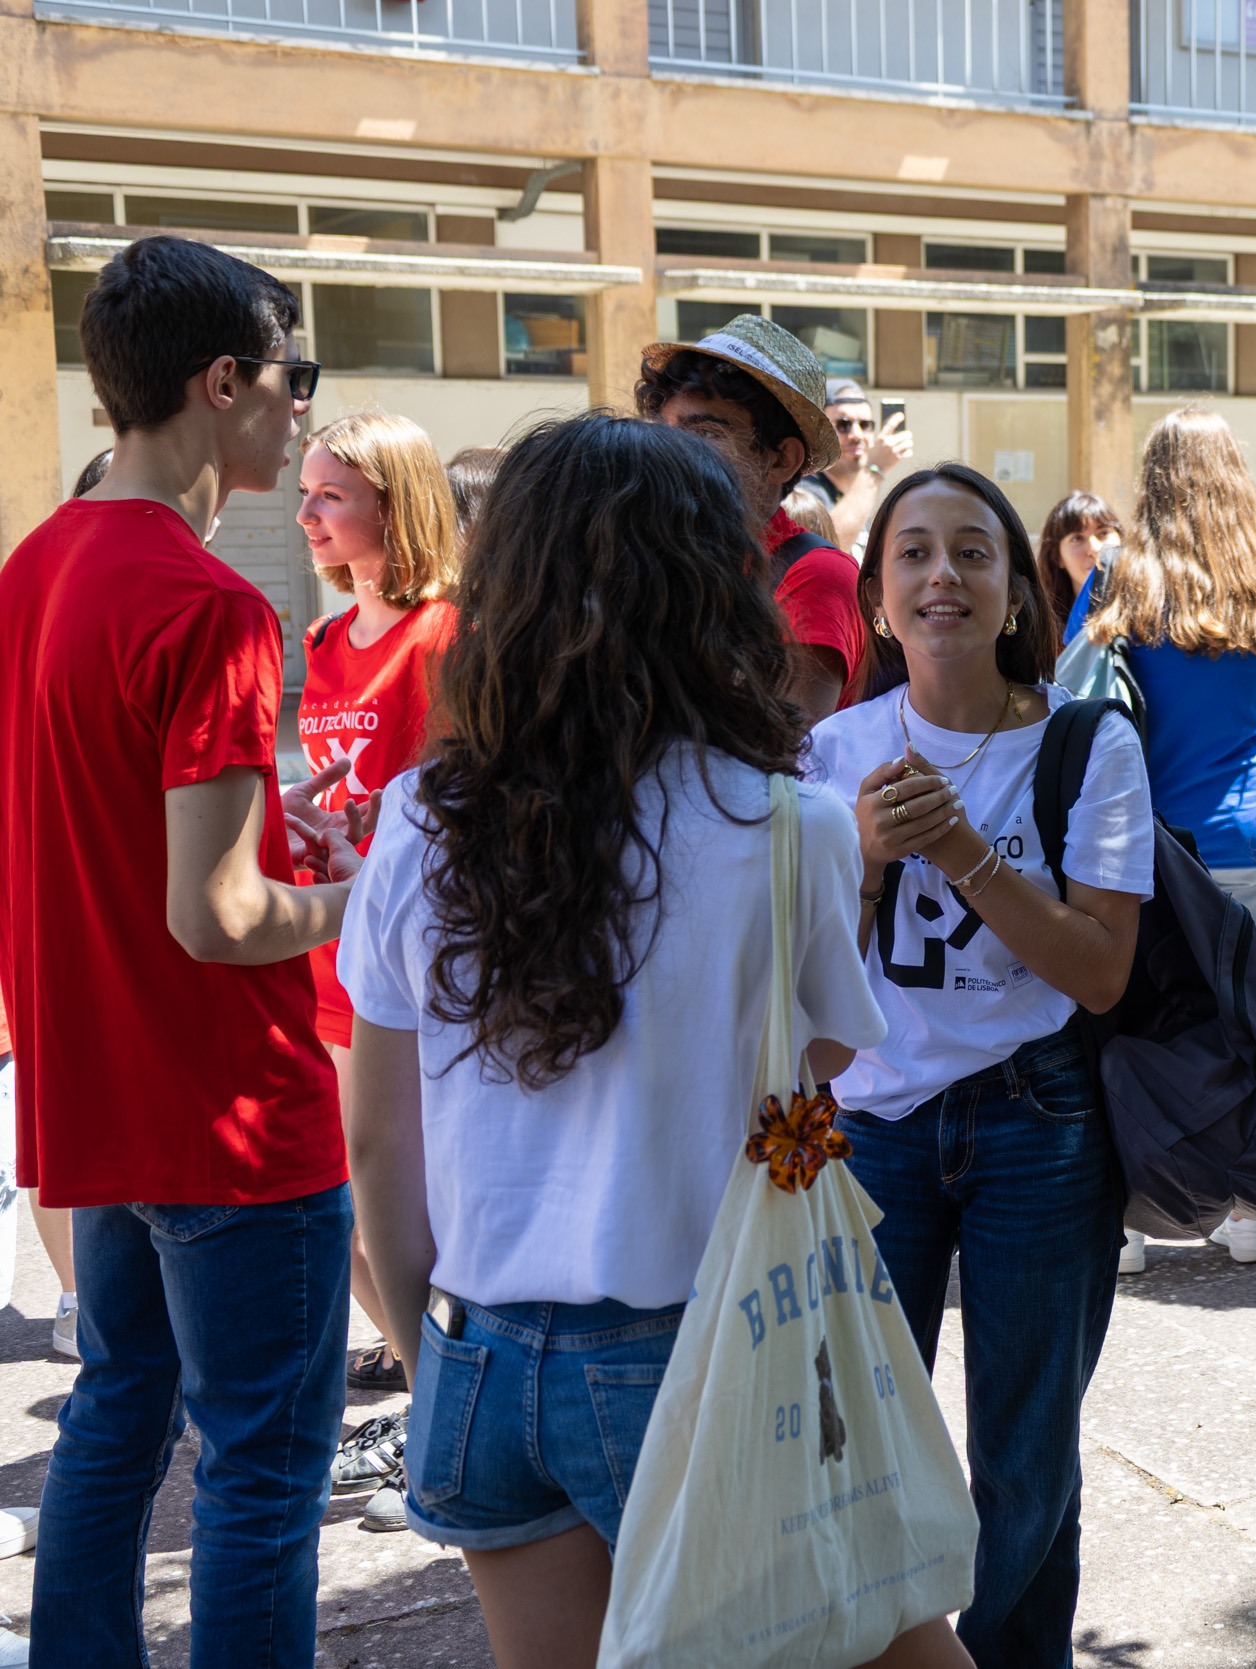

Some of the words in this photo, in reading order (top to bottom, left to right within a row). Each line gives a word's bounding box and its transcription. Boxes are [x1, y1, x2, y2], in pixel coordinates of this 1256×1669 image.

[727, 343, 744, 357] ISEL
[874, 1363, 895, 1400] 06
[775, 1403, 801, 1443] 20
